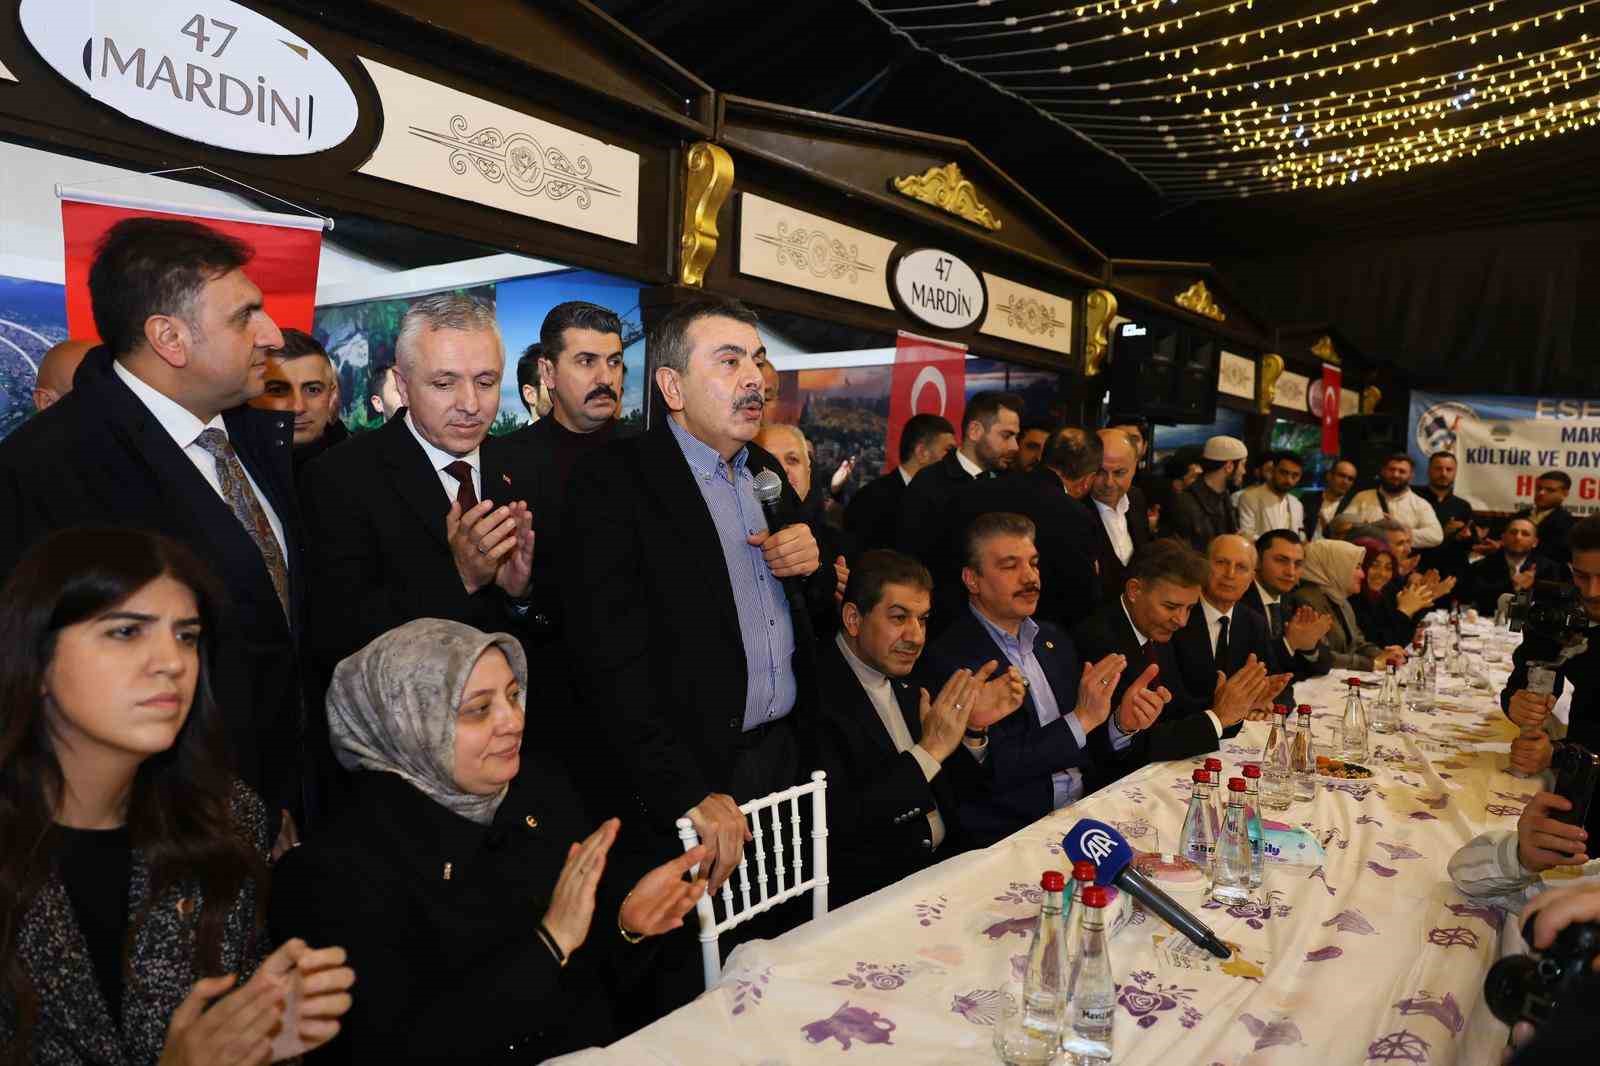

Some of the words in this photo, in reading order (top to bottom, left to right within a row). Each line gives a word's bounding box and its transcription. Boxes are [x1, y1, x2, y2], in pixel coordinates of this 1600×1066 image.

[180, 13, 238, 58] 47
[101, 37, 301, 133] MARDİN
[935, 256, 953, 282] 47
[912, 281, 971, 317] MARDİN
[1466, 446, 1531, 466] KÜLTÜR
[1538, 450, 1560, 467] VE
[1566, 451, 1600, 468] DAY
